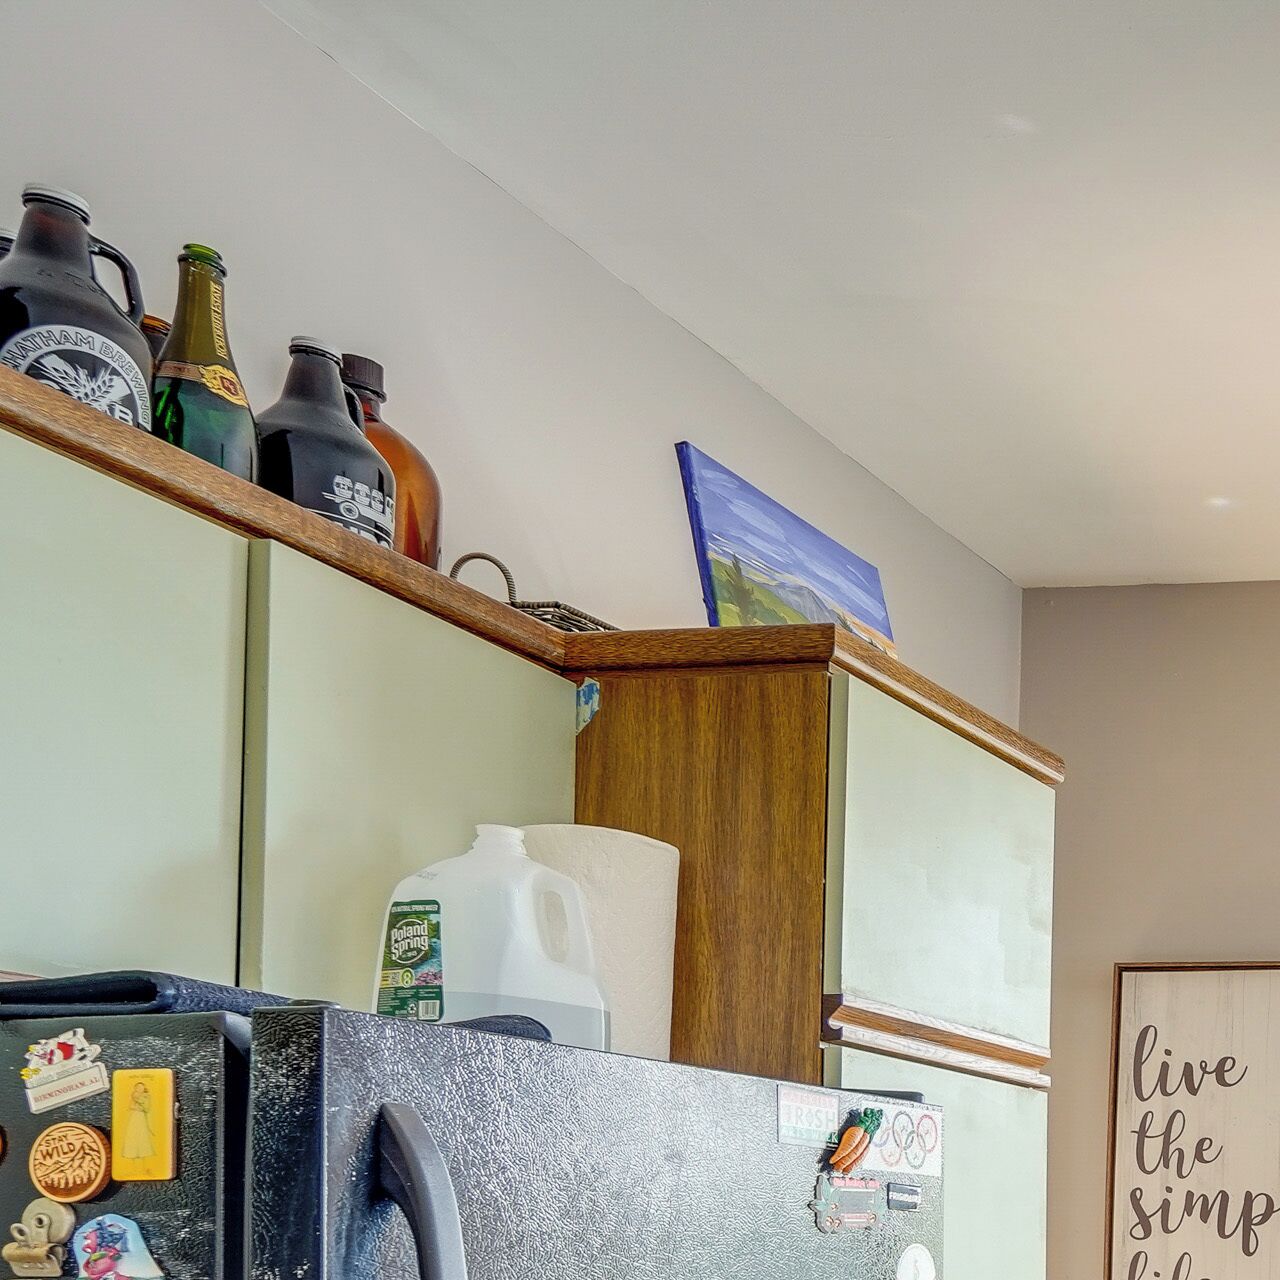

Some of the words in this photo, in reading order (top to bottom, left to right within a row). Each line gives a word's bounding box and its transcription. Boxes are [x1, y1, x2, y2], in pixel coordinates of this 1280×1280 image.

[1, 329, 95, 372] HATHAM
[100, 341, 151, 424] BREWING
[391, 920, 428, 944] Poland
[391, 936, 429, 960] Spring
[1132, 1024, 1248, 1102] live
[40, 1141, 76, 1161] WILD
[44, 1133, 68, 1148] STAY
[1129, 1109, 1223, 1179] the
